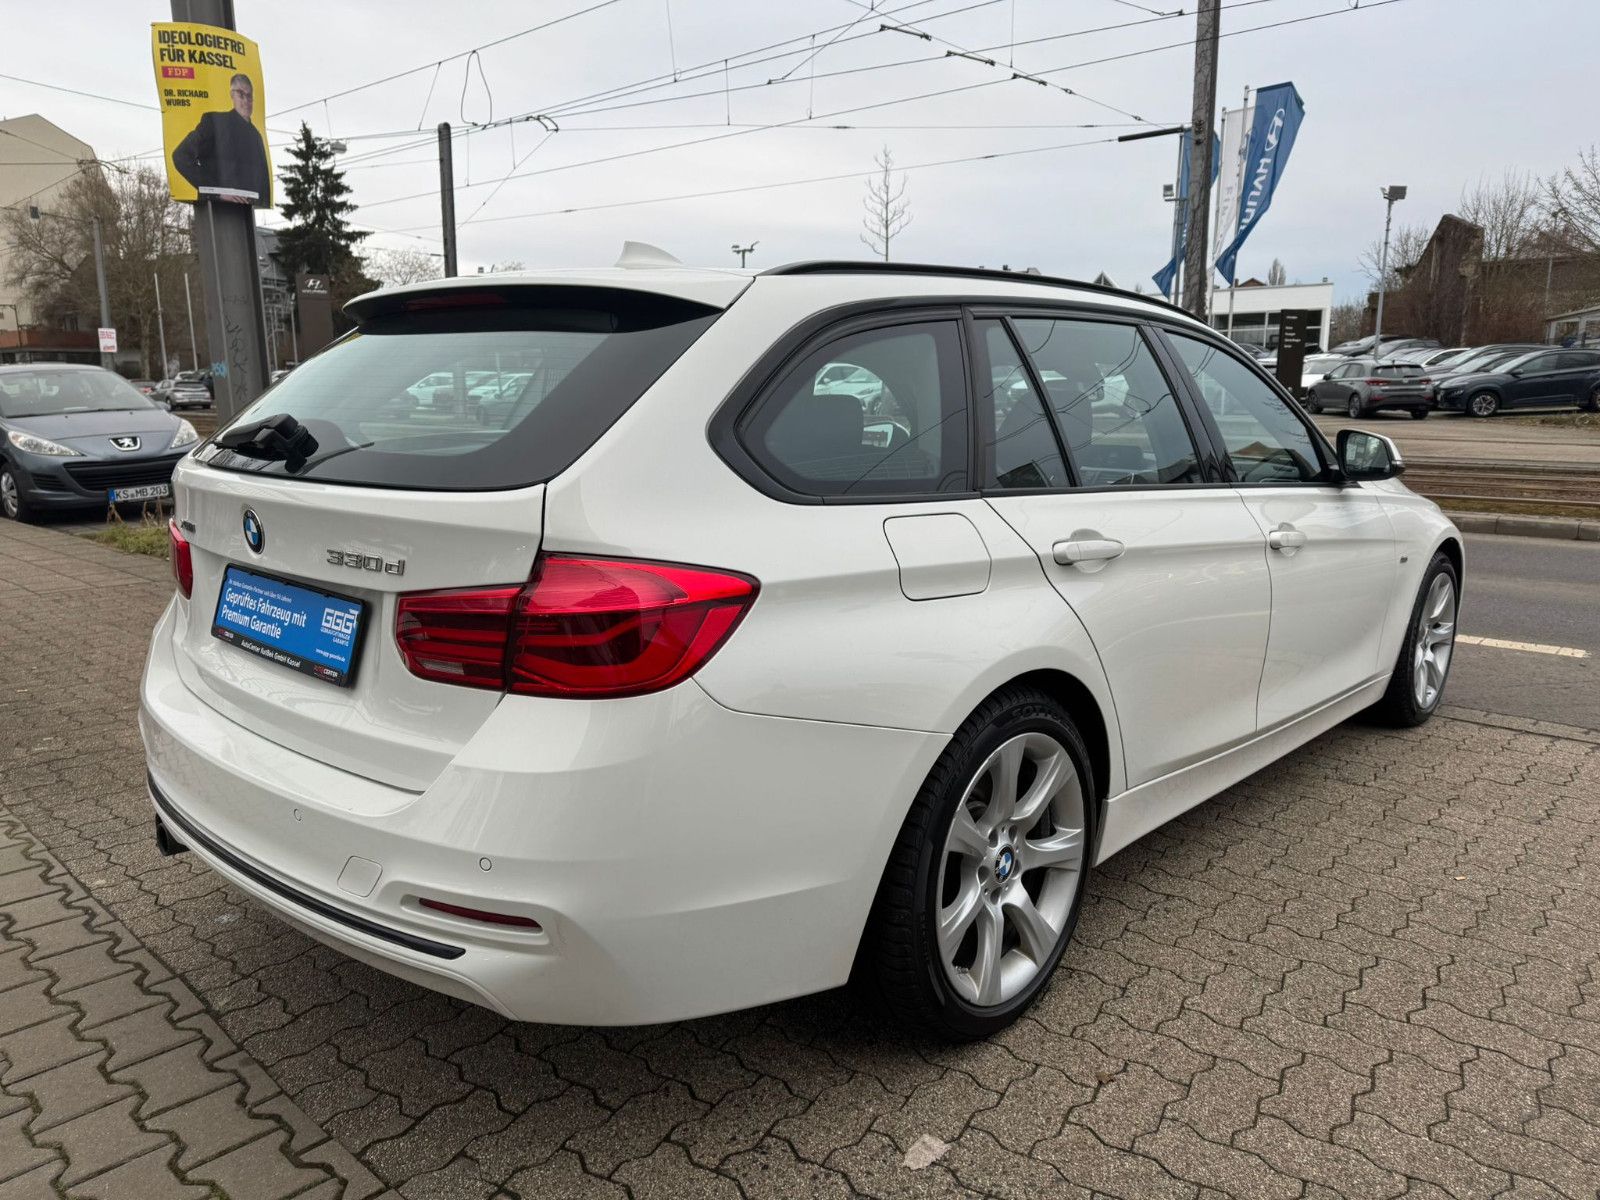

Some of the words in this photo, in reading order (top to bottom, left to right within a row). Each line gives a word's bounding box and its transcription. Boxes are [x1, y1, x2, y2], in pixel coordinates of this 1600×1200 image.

[158, 30, 246, 56] IDEOLOGIEFREI
[160, 44, 185, 62] FÜR
[189, 49, 237, 70] KASSEL
[167, 67, 189, 77] FDP
[164, 88, 176, 98] DR.
[177, 89, 209, 99] RICHARD
[165, 98, 191, 107] WURBS
[115, 489, 130, 499] KS
[135, 486, 149, 498] MB
[150, 485, 168, 496] 203
[326, 549, 406, 576] 330d
[225, 587, 257, 611] Geprüftes
[257, 598, 292, 626] Fahrzeug
[292, 611, 307, 628] mit
[221, 604, 251, 628] Premium
[250, 615, 282, 639] Garantie
[322, 608, 354, 634] GGG
